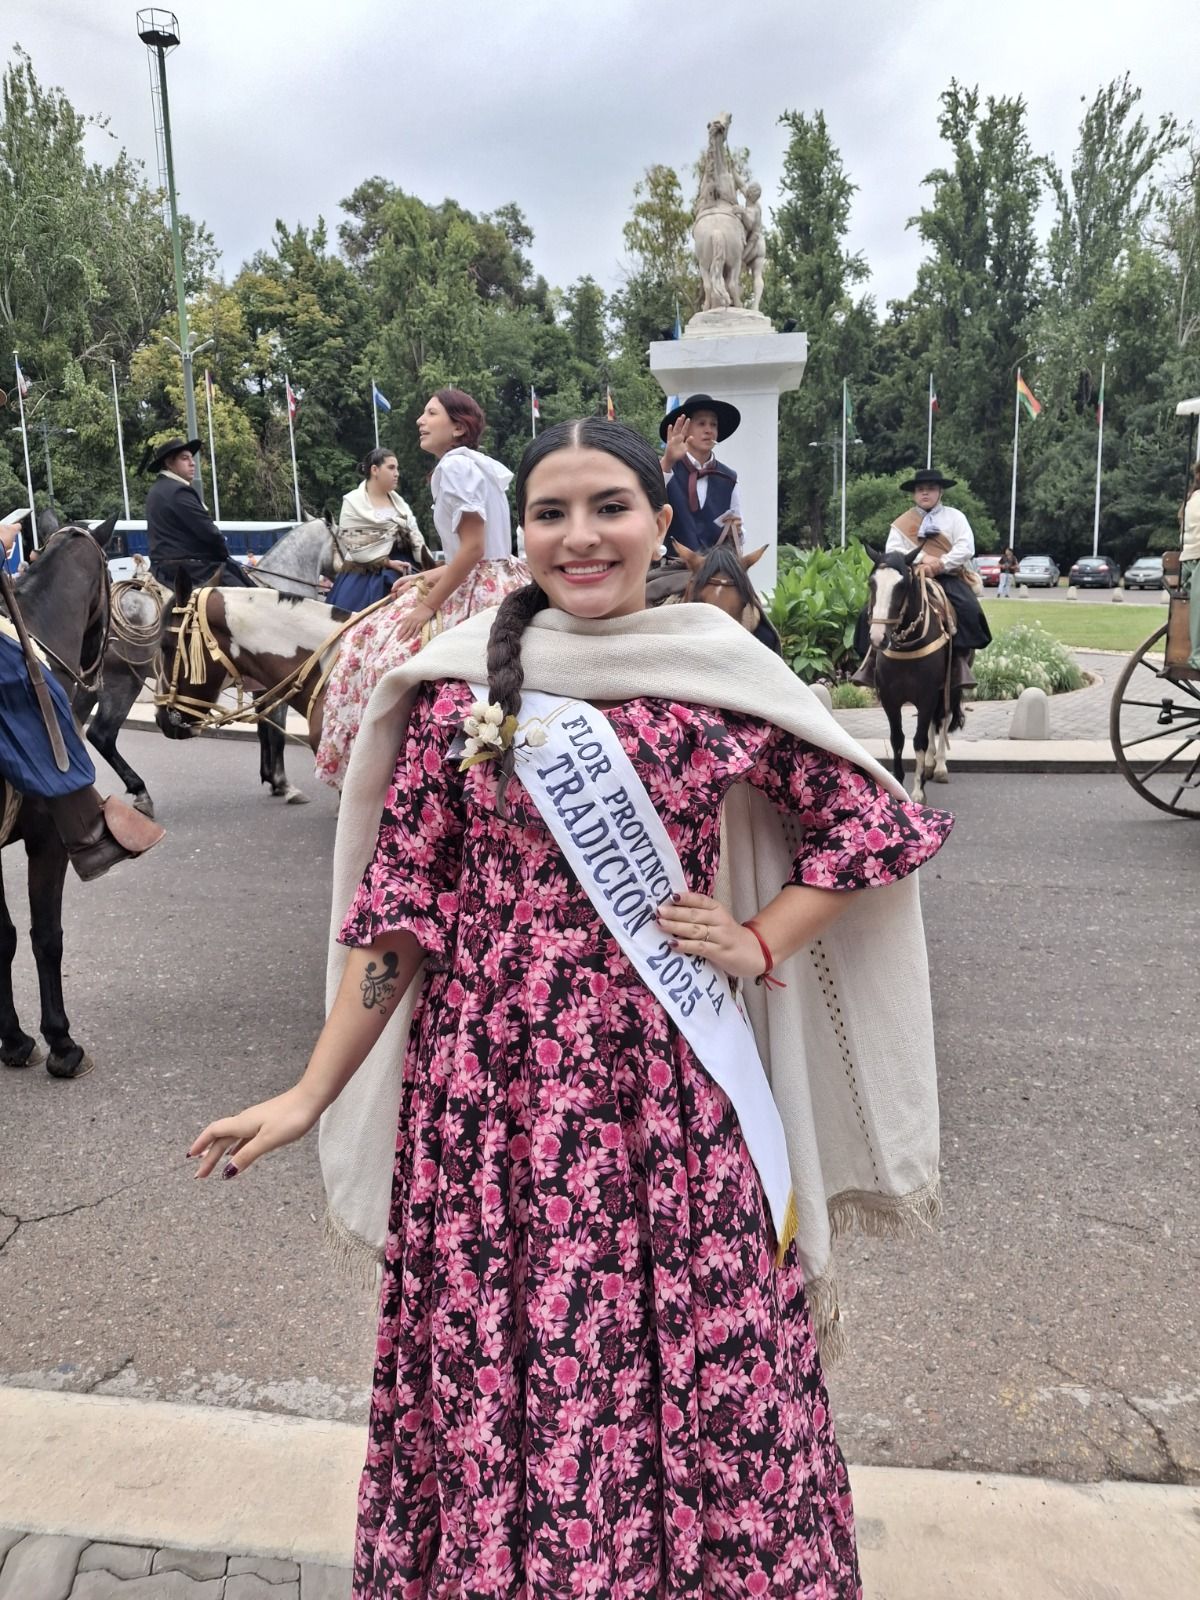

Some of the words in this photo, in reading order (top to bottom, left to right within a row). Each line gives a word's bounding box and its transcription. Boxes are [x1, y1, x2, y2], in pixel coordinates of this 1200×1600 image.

[561, 714, 613, 783] FLOR
[602, 786, 677, 908] PROVINCI
[705, 973, 726, 1017] LA
[646, 941, 704, 1018] 2025
